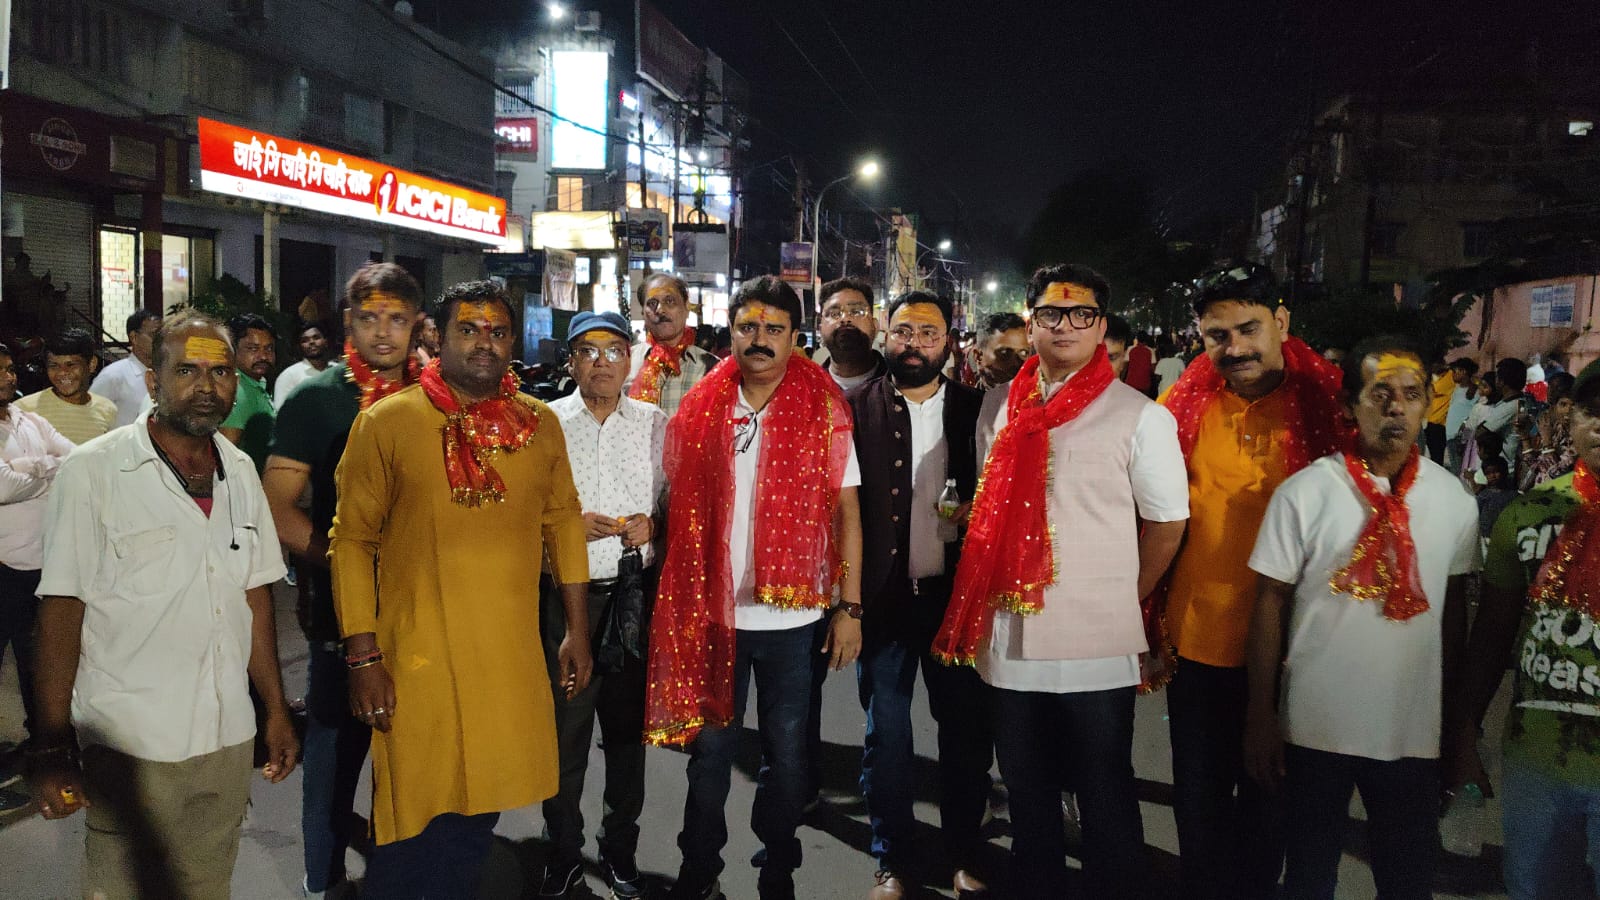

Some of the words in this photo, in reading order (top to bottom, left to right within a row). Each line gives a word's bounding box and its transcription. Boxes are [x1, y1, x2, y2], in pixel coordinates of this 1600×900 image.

[495, 126, 532, 142] CHI
[396, 182, 451, 223] ICICI
[451, 196, 501, 234] Bank
